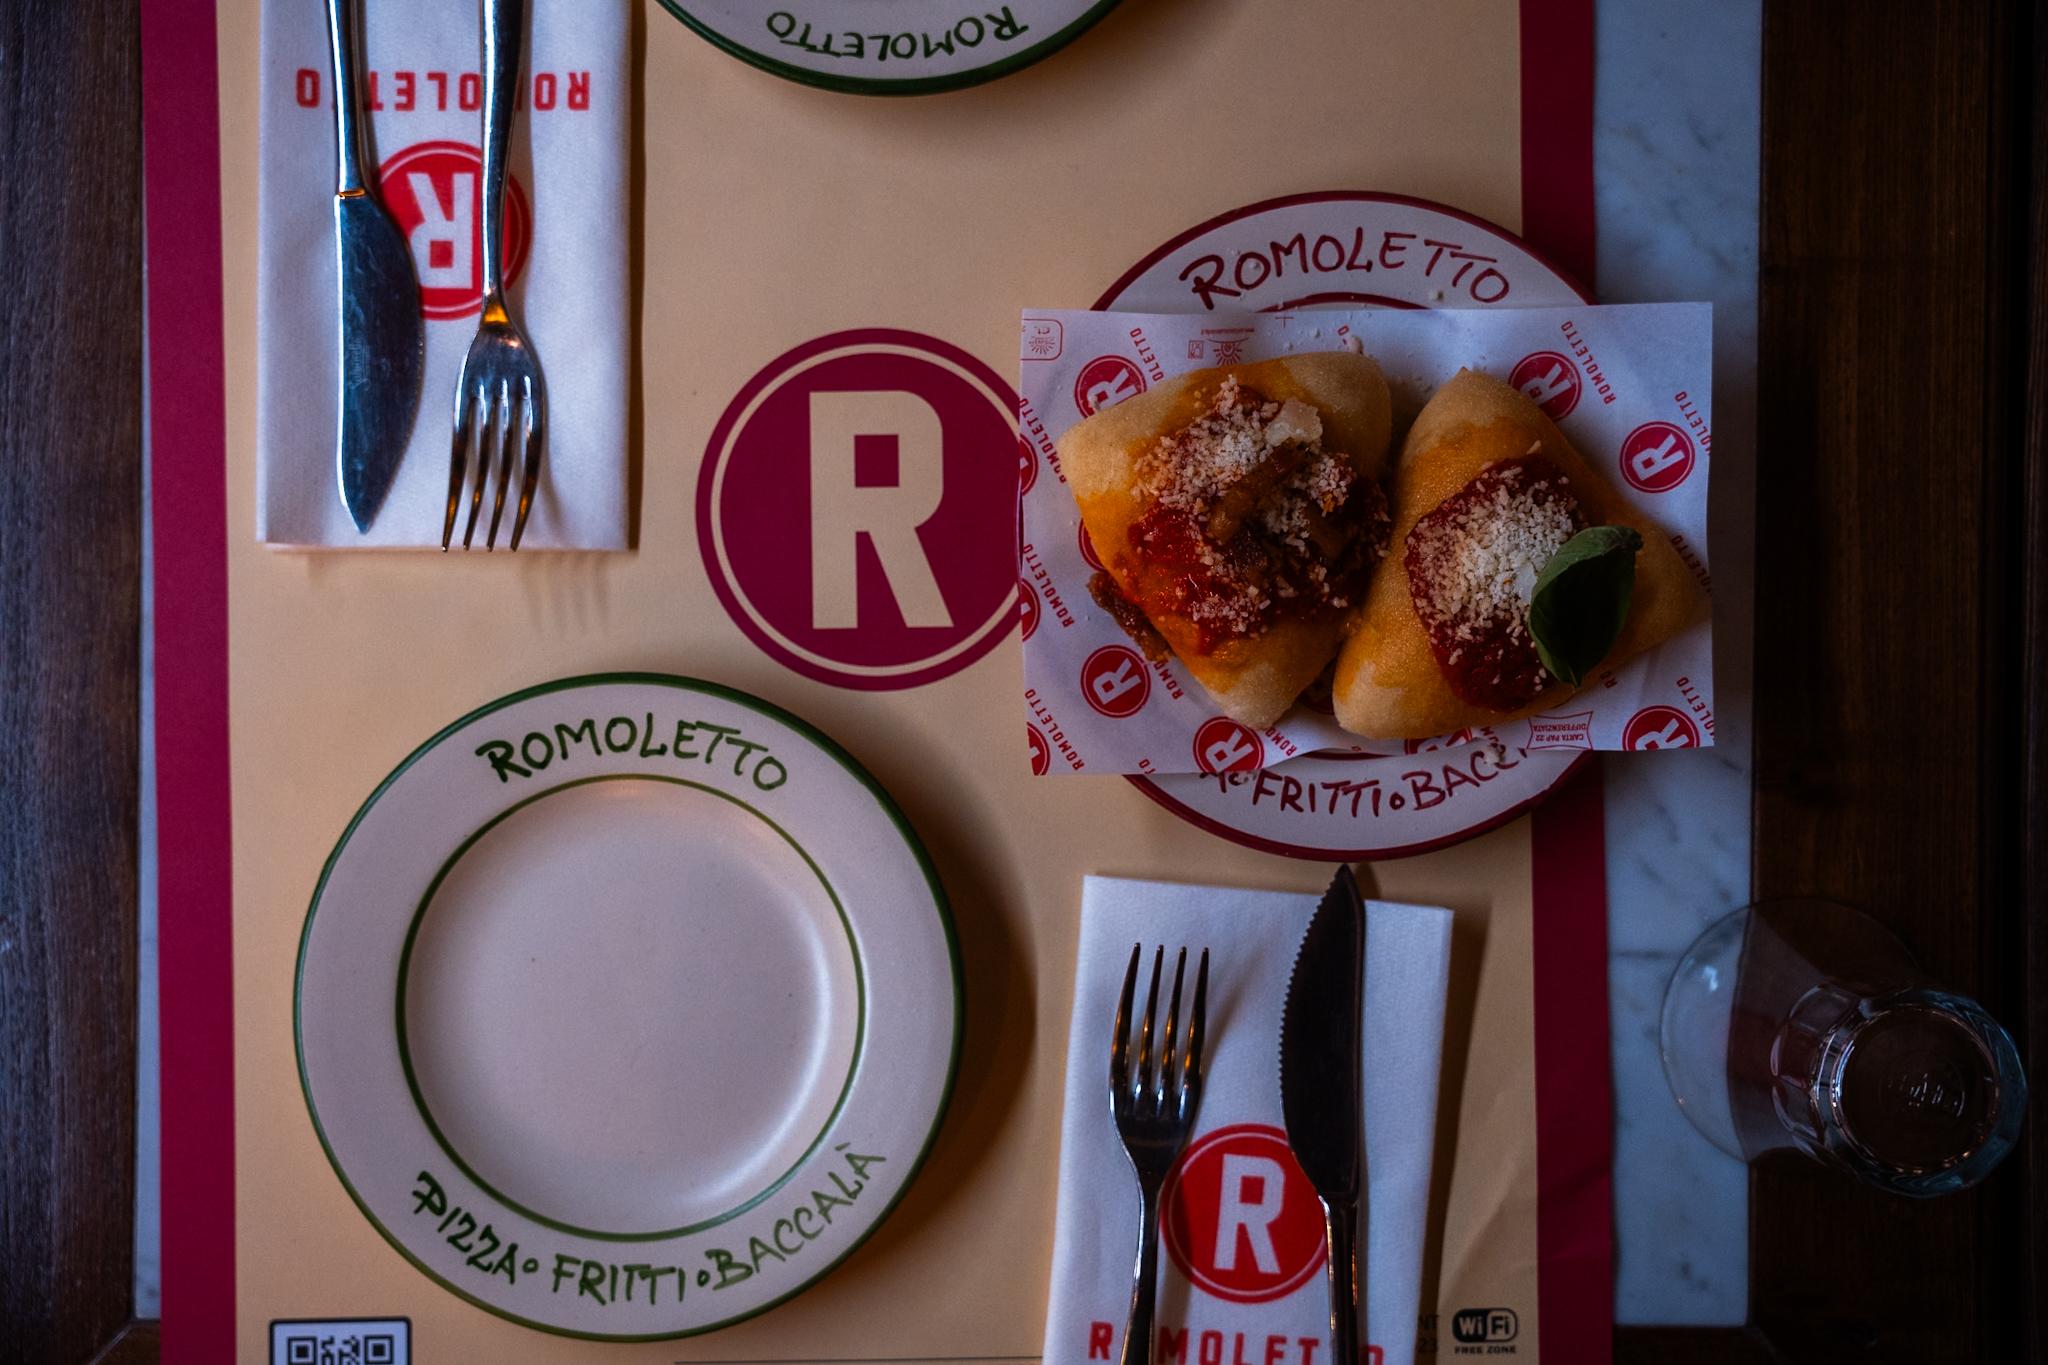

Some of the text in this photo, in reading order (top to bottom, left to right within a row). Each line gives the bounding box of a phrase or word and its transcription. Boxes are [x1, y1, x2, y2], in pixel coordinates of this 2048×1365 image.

[766, 6, 1029, 61] ROMOLETTO
[296, 68, 590, 111] ROOLETO
[407, 171, 475, 289] R
[1179, 227, 1509, 310] ROMOLETTO
[1086, 367, 1141, 411] R
[1518, 362, 1573, 406] R
[1561, 320, 1616, 405] ROMOLETTO
[1674, 391, 1713, 455] OLETTO
[1631, 432, 1686, 482] R
[809, 389, 956, 630] R
[1023, 544, 1075, 628] ROMOLETTO
[1672, 535, 1711, 593] OLETTO
[1092, 657, 1143, 706] R
[1676, 677, 1714, 736] OLETTO
[475, 712, 788, 791] ROMOLETTO
[1024, 688, 1085, 771] ROMOLETTO
[1205, 727, 1255, 771] R
[1253, 768, 1380, 818] FRITTI
[412, 1142, 887, 1306] PIZZA FRITTI BACCALÀ
[1213, 1152, 1287, 1275] R
[1455, 1345, 1516, 1354] FREE ZONE
[1457, 1314, 1511, 1337] WiFi
